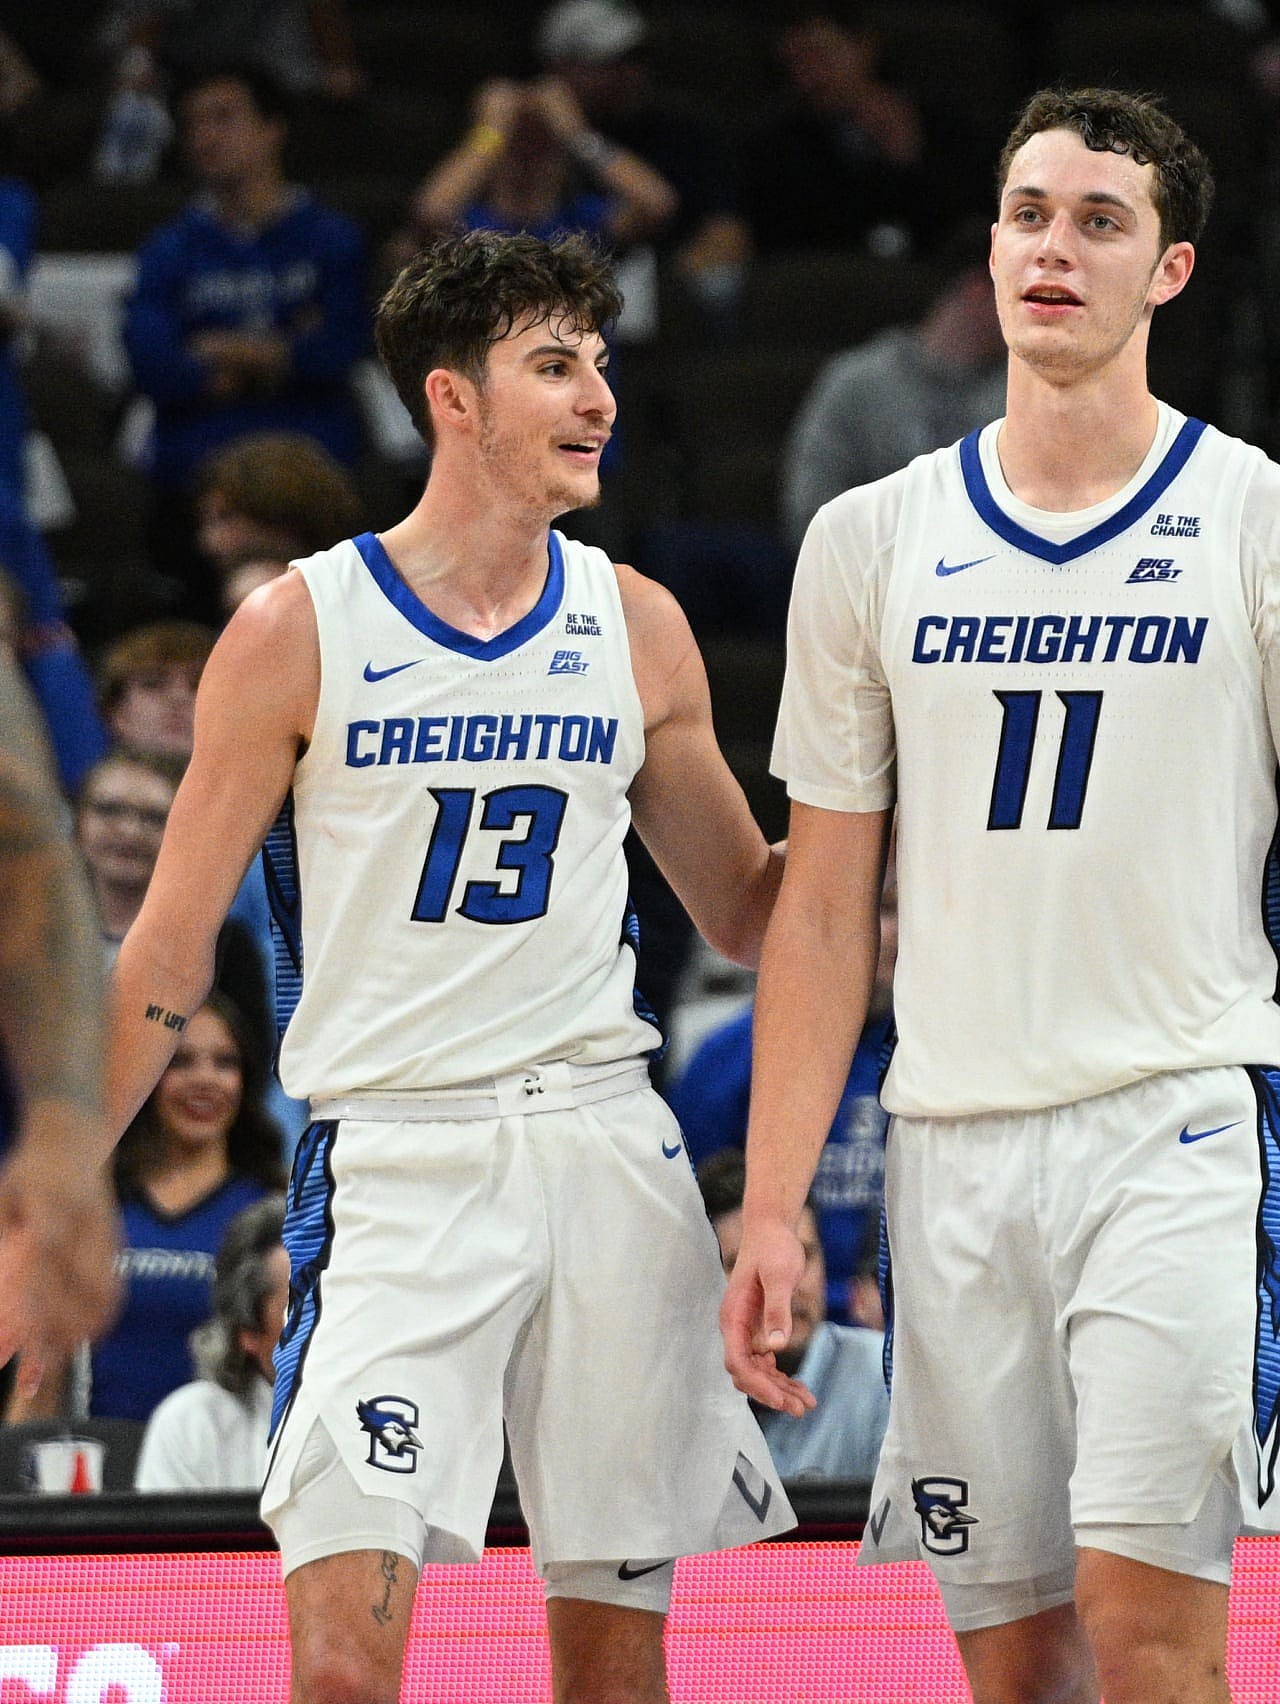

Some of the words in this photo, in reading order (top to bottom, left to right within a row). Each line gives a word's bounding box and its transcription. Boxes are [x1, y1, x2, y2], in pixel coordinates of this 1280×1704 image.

[1156, 513, 1174, 525] BE
[1177, 515, 1201, 527] THE
[1150, 525, 1201, 538] CHANGE
[1135, 557, 1175, 569] BIG
[1129, 568, 1184, 579] EAST
[566, 612, 579, 624] BE
[580, 613, 598, 626] THE
[565, 623, 604, 636] CHANGE
[911, 614, 1209, 664] CREIGHTON
[553, 650, 583, 661] BIG
[549, 660, 590, 672] EAST
[345, 713, 619, 768] CREIGHTON
[986, 689, 1104, 831] 11
[410, 783, 570, 925] 13
